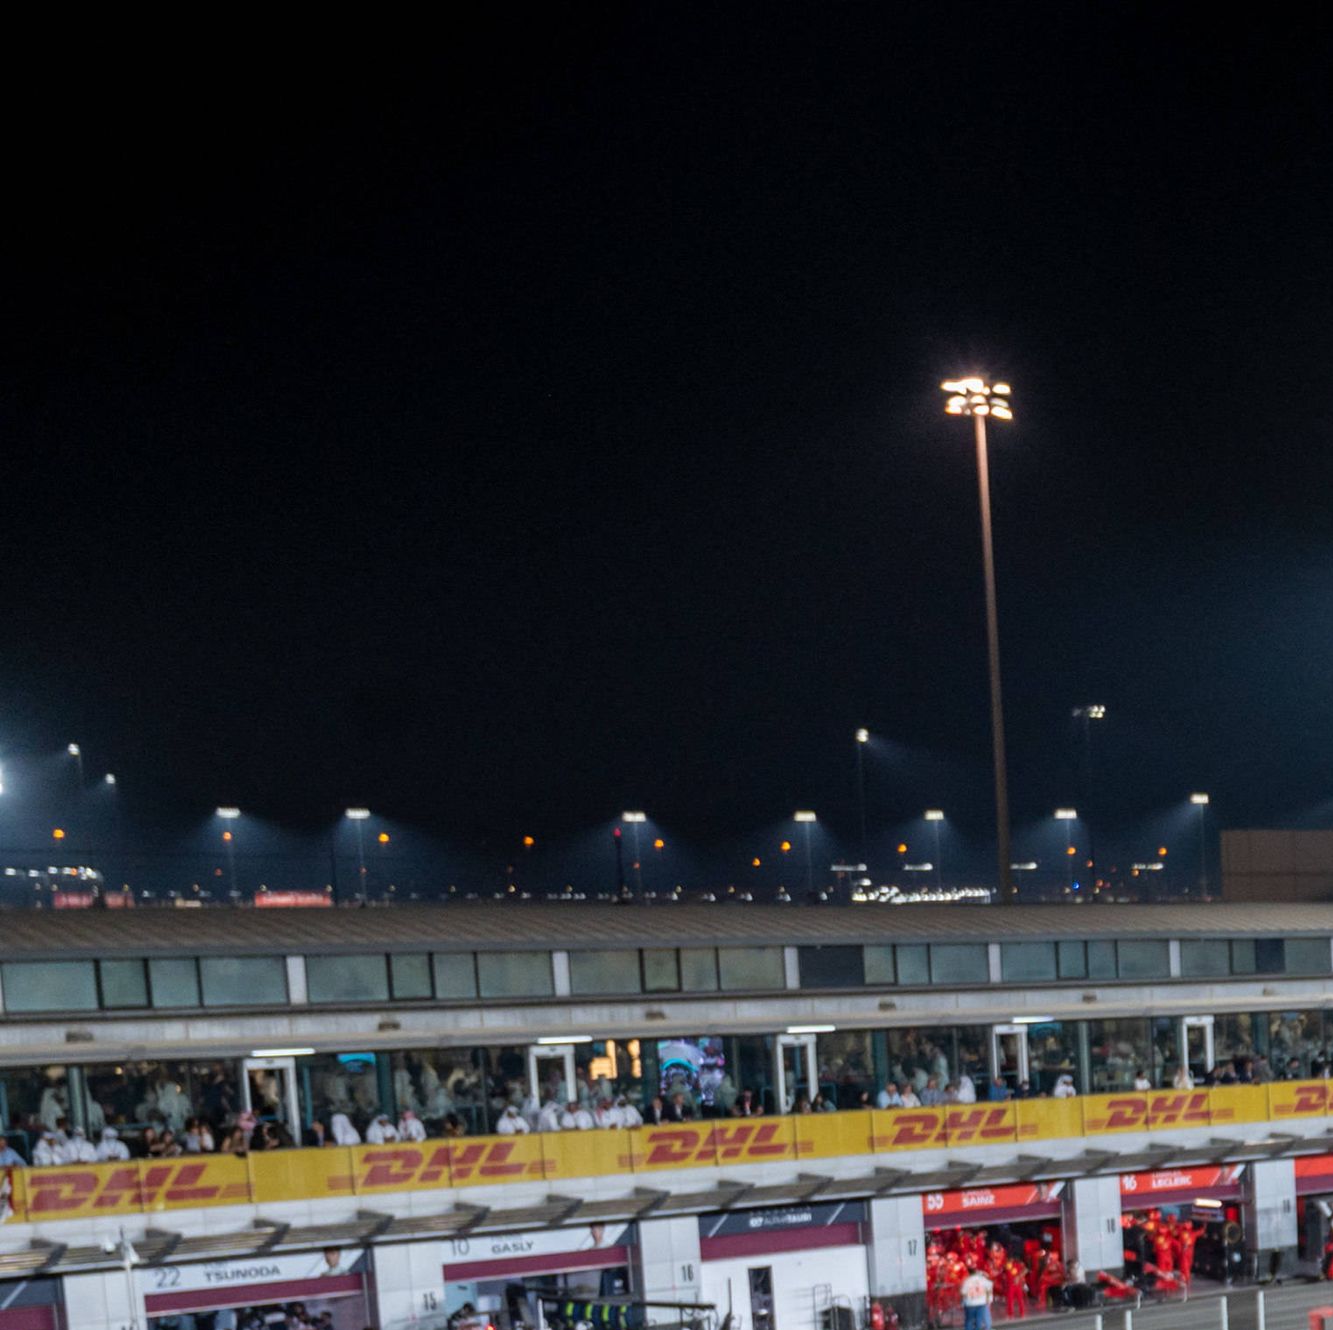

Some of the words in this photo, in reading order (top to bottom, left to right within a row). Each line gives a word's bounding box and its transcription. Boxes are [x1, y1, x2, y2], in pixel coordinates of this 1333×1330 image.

[891, 1108, 1017, 1147] DHL
[1106, 1094, 1214, 1129] DHL
[645, 1123, 793, 1165] DHL
[360, 1141, 533, 1188] DHL
[28, 1162, 221, 1215] DHL
[491, 1240, 534, 1255] GASLY
[154, 1266, 182, 1288] 22
[205, 1264, 281, 1283] TSUNODA
